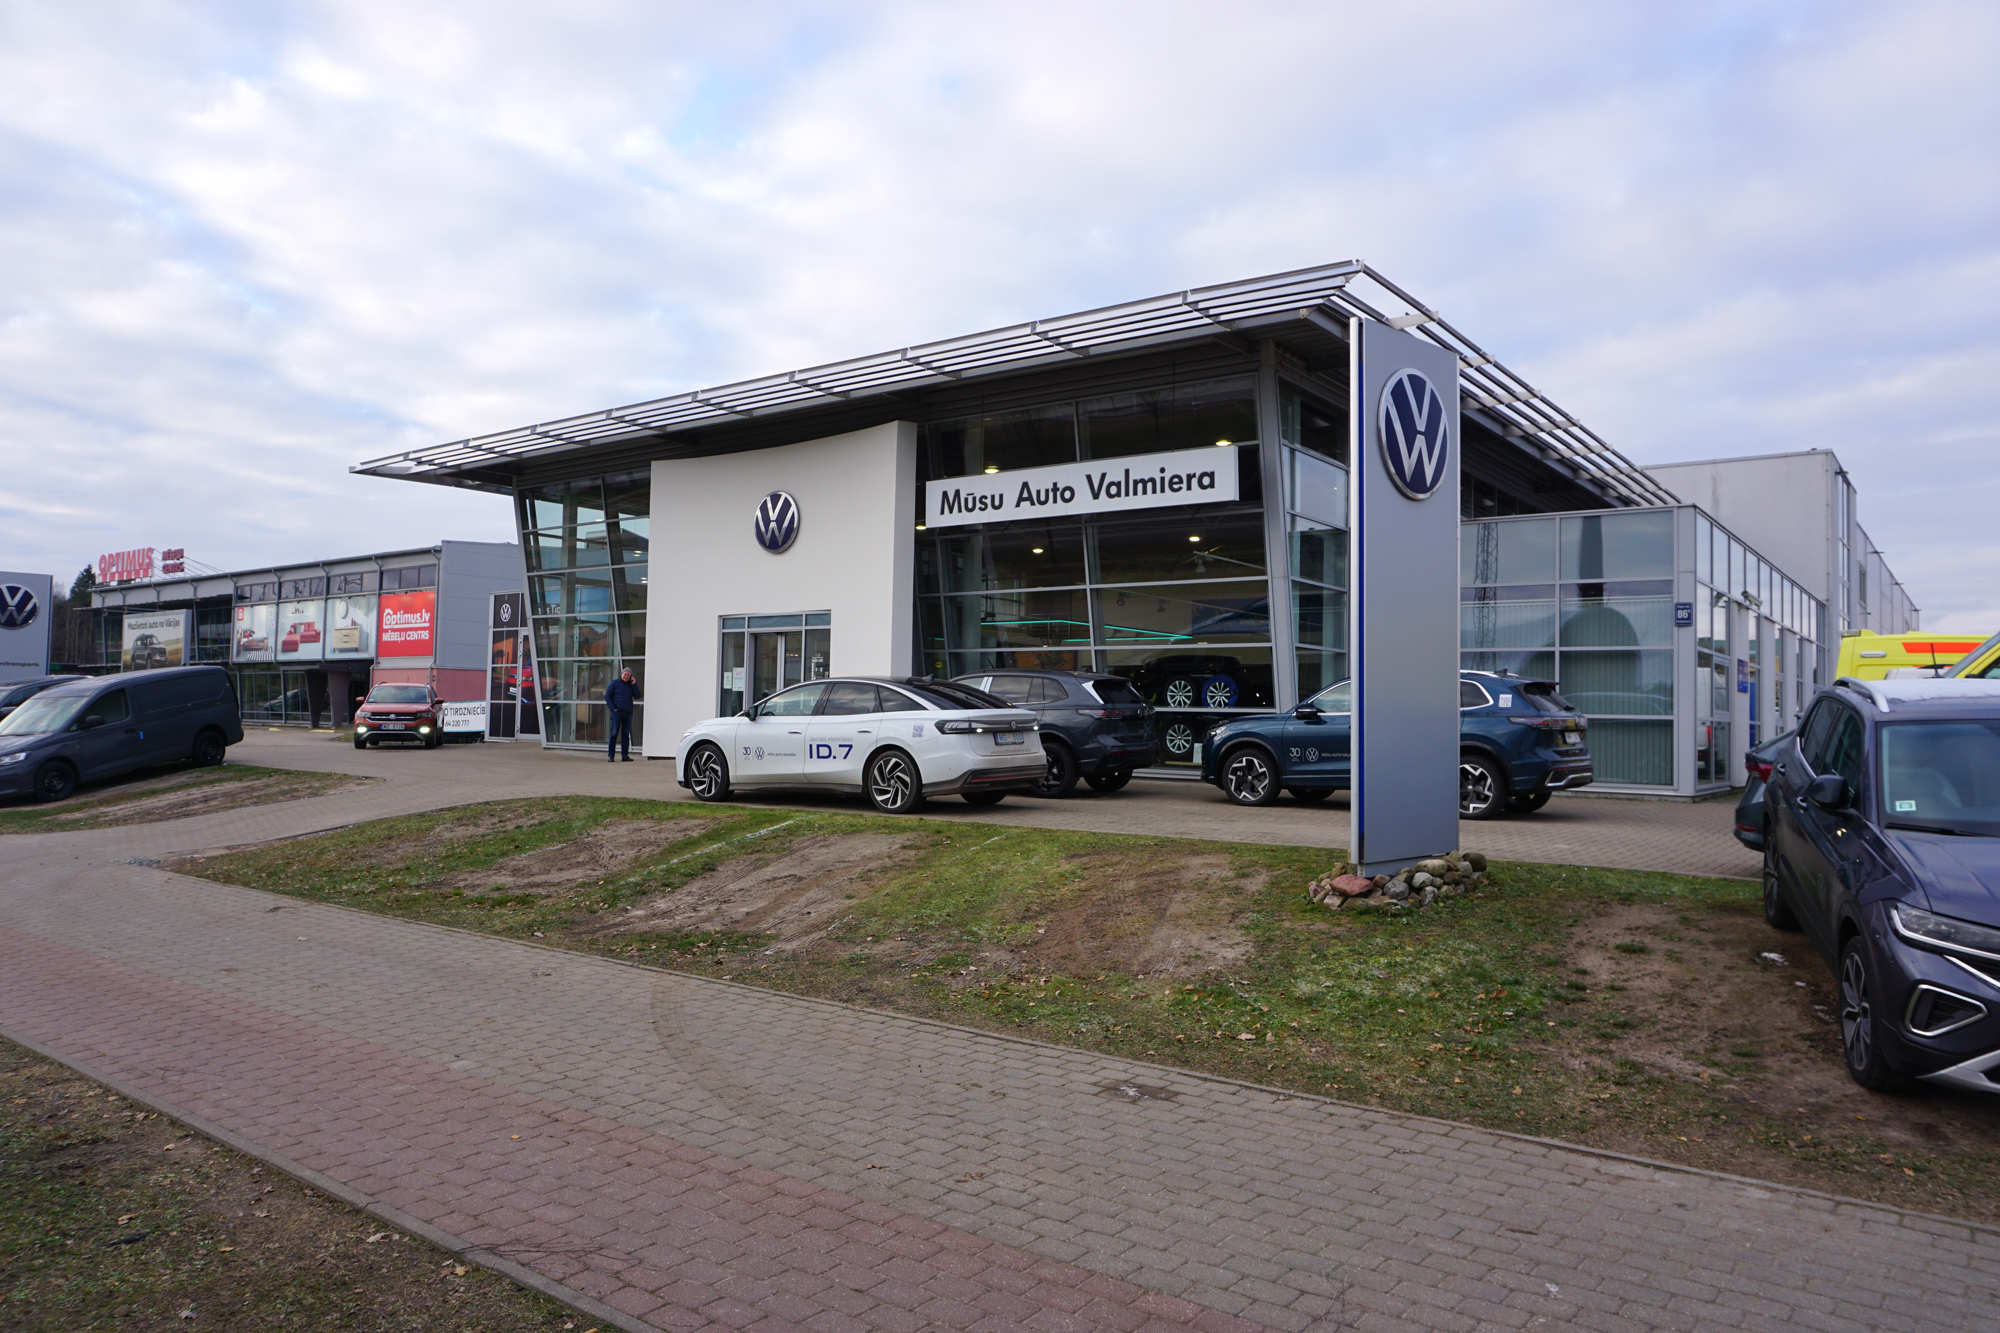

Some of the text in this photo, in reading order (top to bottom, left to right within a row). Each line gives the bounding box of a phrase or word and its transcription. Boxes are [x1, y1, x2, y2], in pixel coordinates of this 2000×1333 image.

[939, 467, 1215, 516] Mūsu Auto Valmiera
[99, 547, 153, 575] OPTIMUS
[159, 620, 165, 628] no
[385, 609, 430, 627] optimus.lv
[382, 630, 429, 643] MĒBEĻU CENTRS
[452, 719, 460, 727] 220
[461, 719, 470, 727] 777
[743, 747, 751, 756] 30
[809, 744, 853, 759] ID.7
[1290, 748, 1301, 757] 30
